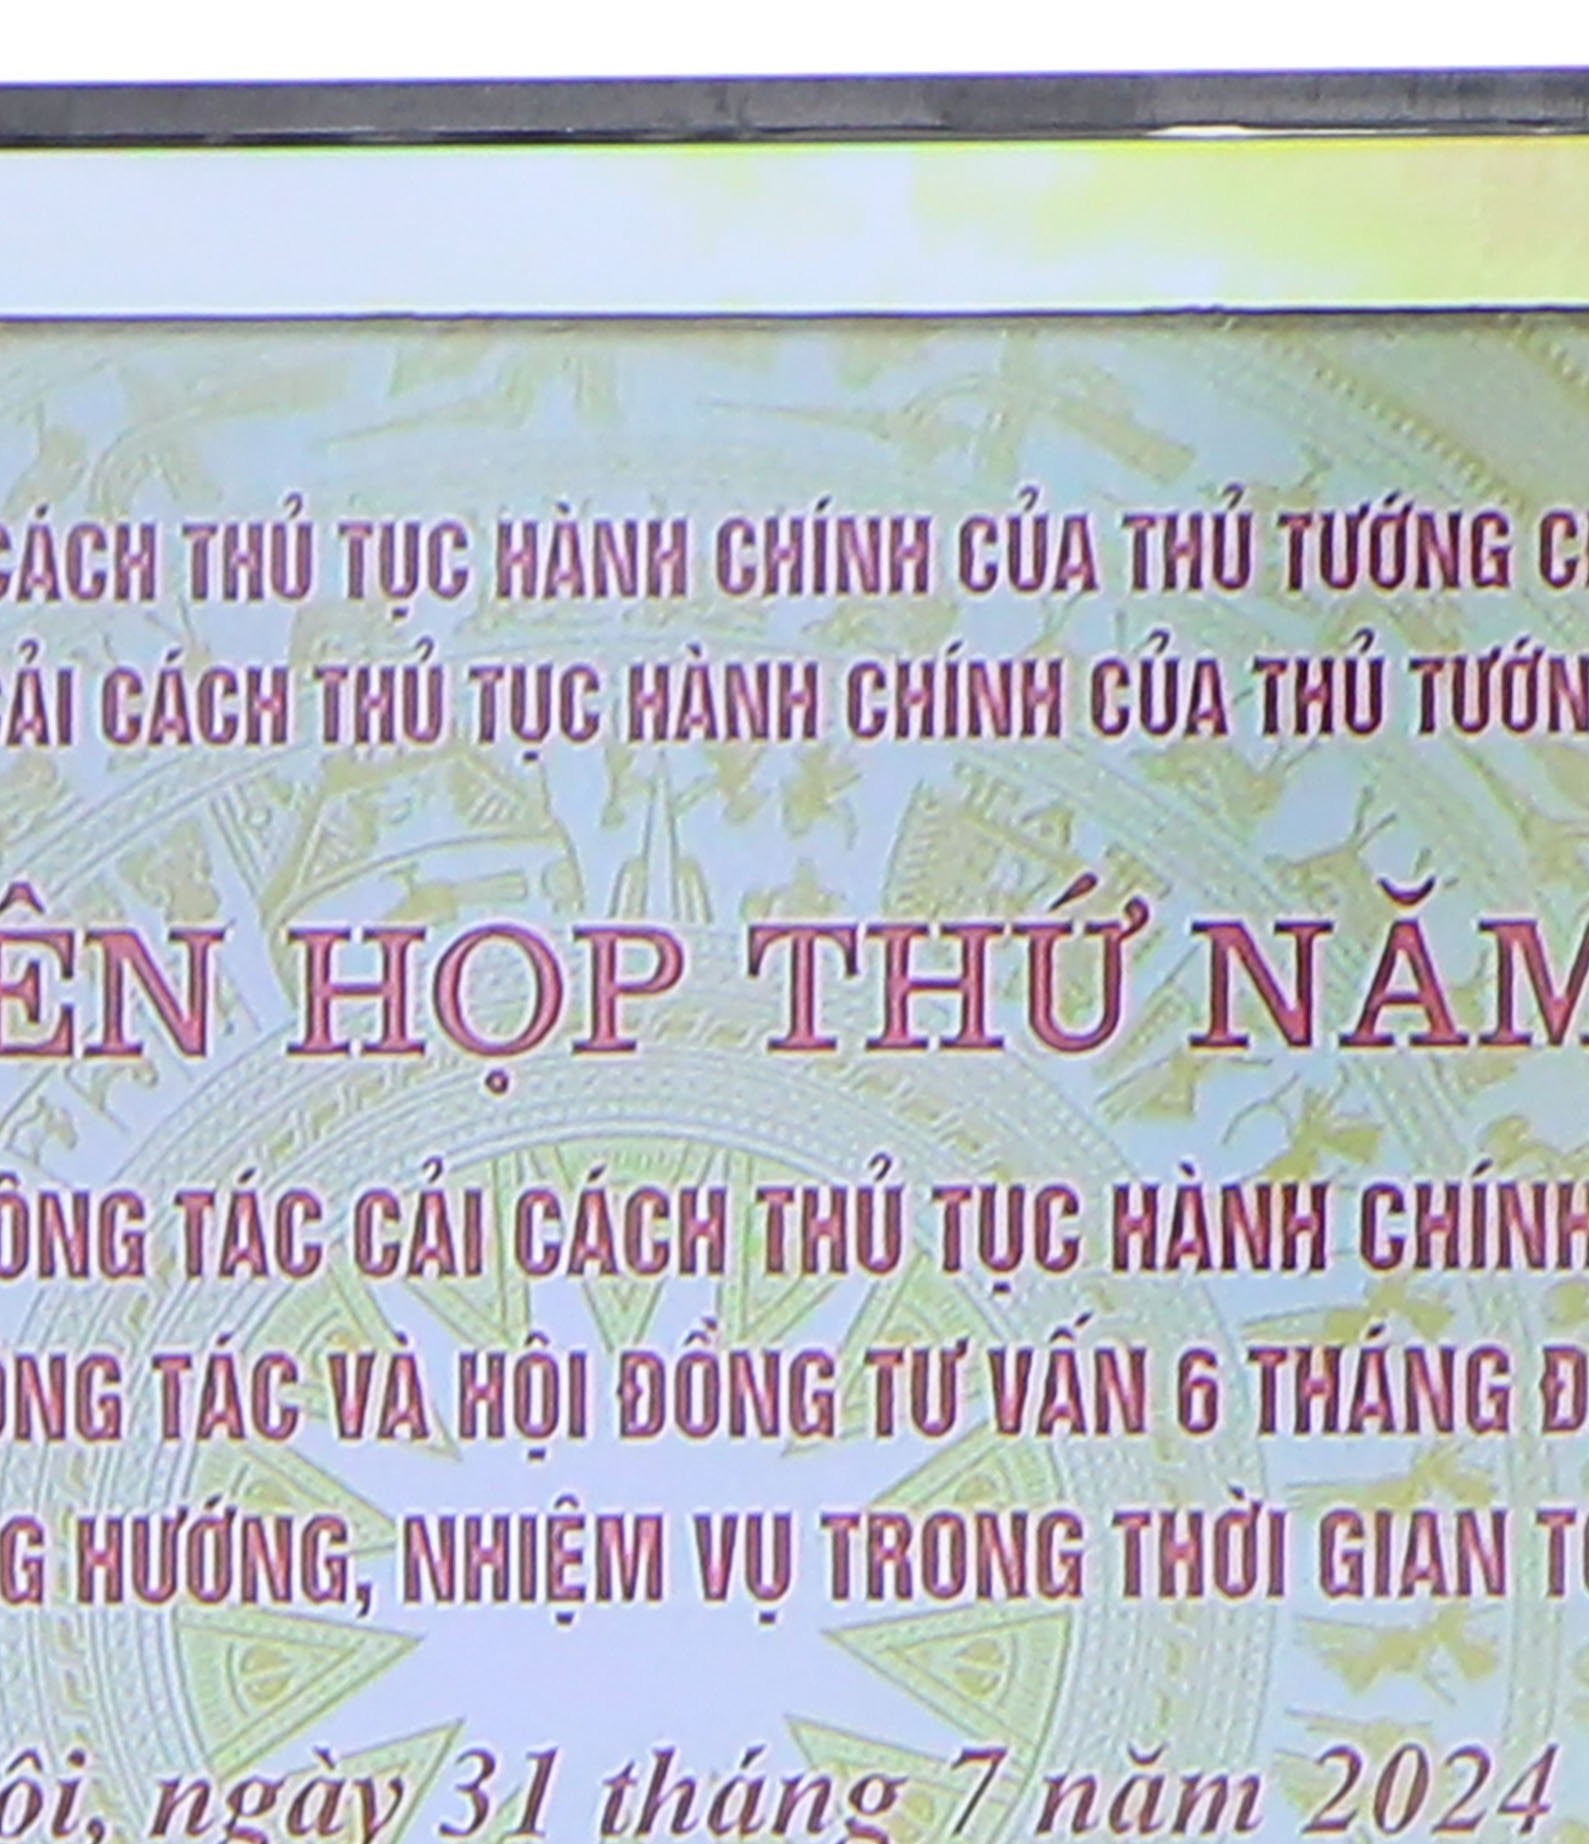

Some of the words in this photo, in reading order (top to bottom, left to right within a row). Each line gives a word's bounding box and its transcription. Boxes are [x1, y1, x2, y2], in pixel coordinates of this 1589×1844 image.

[183, 494, 311, 600] THỦ
[339, 520, 469, 618] TỤC
[498, 503, 685, 597] HÀNH
[717, 498, 929, 593] CHÍNH
[960, 486, 1097, 591] CỦA
[1124, 484, 1252, 589] THỦ
[1280, 490, 1510, 591] TƯỚNG
[102, 648, 287, 744] CÁCH
[315, 637, 442, 743] THỦ
[469, 665, 598, 760] TỤC
[630, 643, 816, 740] HÀNH
[848, 640, 1063, 738] CHÍNH
[1093, 630, 1227, 736] CỦA
[1254, 628, 1383, 736] THỦ
[285, 924, 685, 1094] HỌP
[746, 873, 1147, 1053] THỨ
[174, 1168, 323, 1277] TÁC
[355, 1157, 483, 1275] CẢI
[517, 1167, 727, 1275] CÁCH
[757, 1153, 904, 1273] THỦ
[932, 1183, 1081, 1293] TỤC
[1112, 1163, 1329, 1272] HÀNH
[151, 1332, 300, 1439] TÁC
[331, 1332, 428, 1438] VÀ
[460, 1332, 587, 1460] HỘI
[616, 1318, 835, 1438] ĐỒNG
[865, 1342, 970, 1437] TƯ
[986, 1311, 1147, 1436] VẤN
[1177, 1348, 1219, 1433] 6
[1248, 1324, 1511, 1434] THÁNG
[78, 1496, 372, 1616] HƯỚNG,
[402, 1495, 663, 1624] NHIỆM
[694, 1513, 792, 1623] VỤ
[821, 1511, 1084, 1600] TRONG
[1112, 1488, 1287, 1598] THỜI
[1317, 1509, 1506, 1597] GIAN
[438, 1749, 557, 1838] 31
[948, 1747, 1007, 1835] 7
[1035, 1748, 1262, 1833] năm
[1302, 1743, 1562, 1834] 2024
